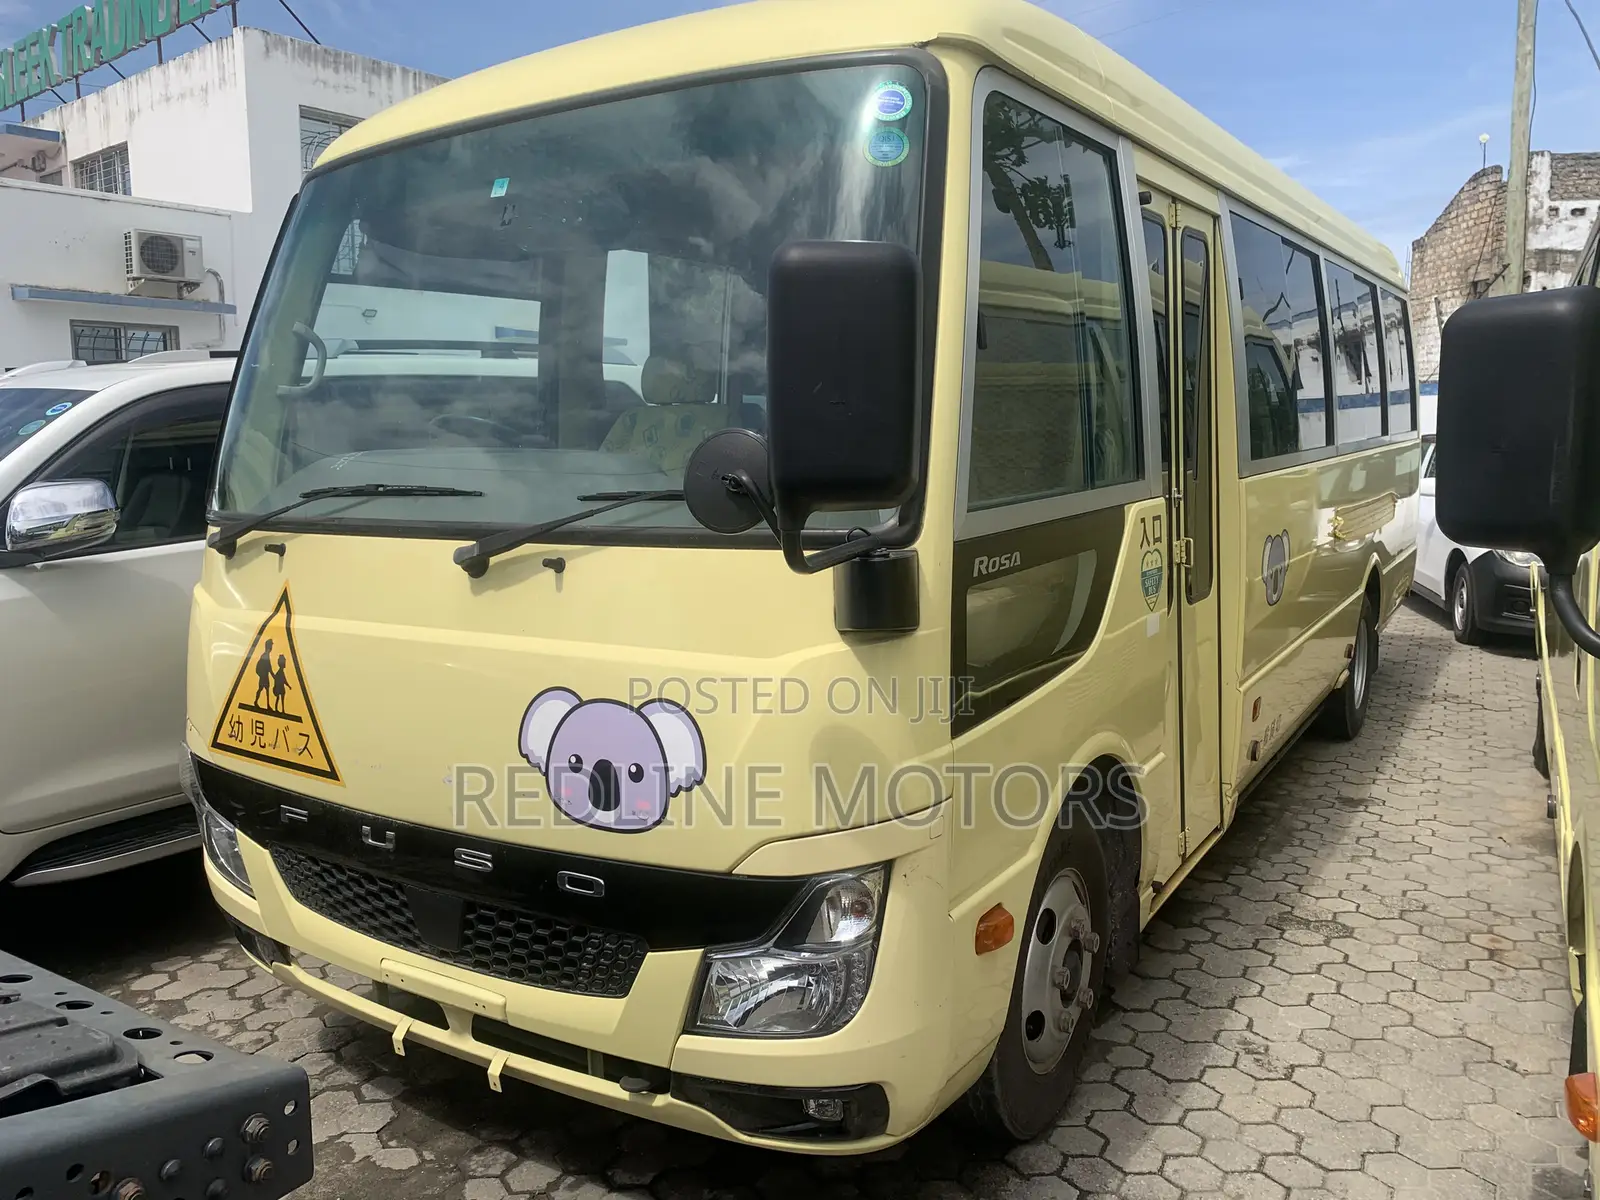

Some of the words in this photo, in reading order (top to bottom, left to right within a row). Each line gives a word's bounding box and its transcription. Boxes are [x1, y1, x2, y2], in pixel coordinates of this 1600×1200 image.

[1139, 514, 1162, 550] 入口
[972, 551, 1021, 578] ROSA
[228, 714, 313, 760] 幼児バス
[280, 804, 605, 898] FUSO
